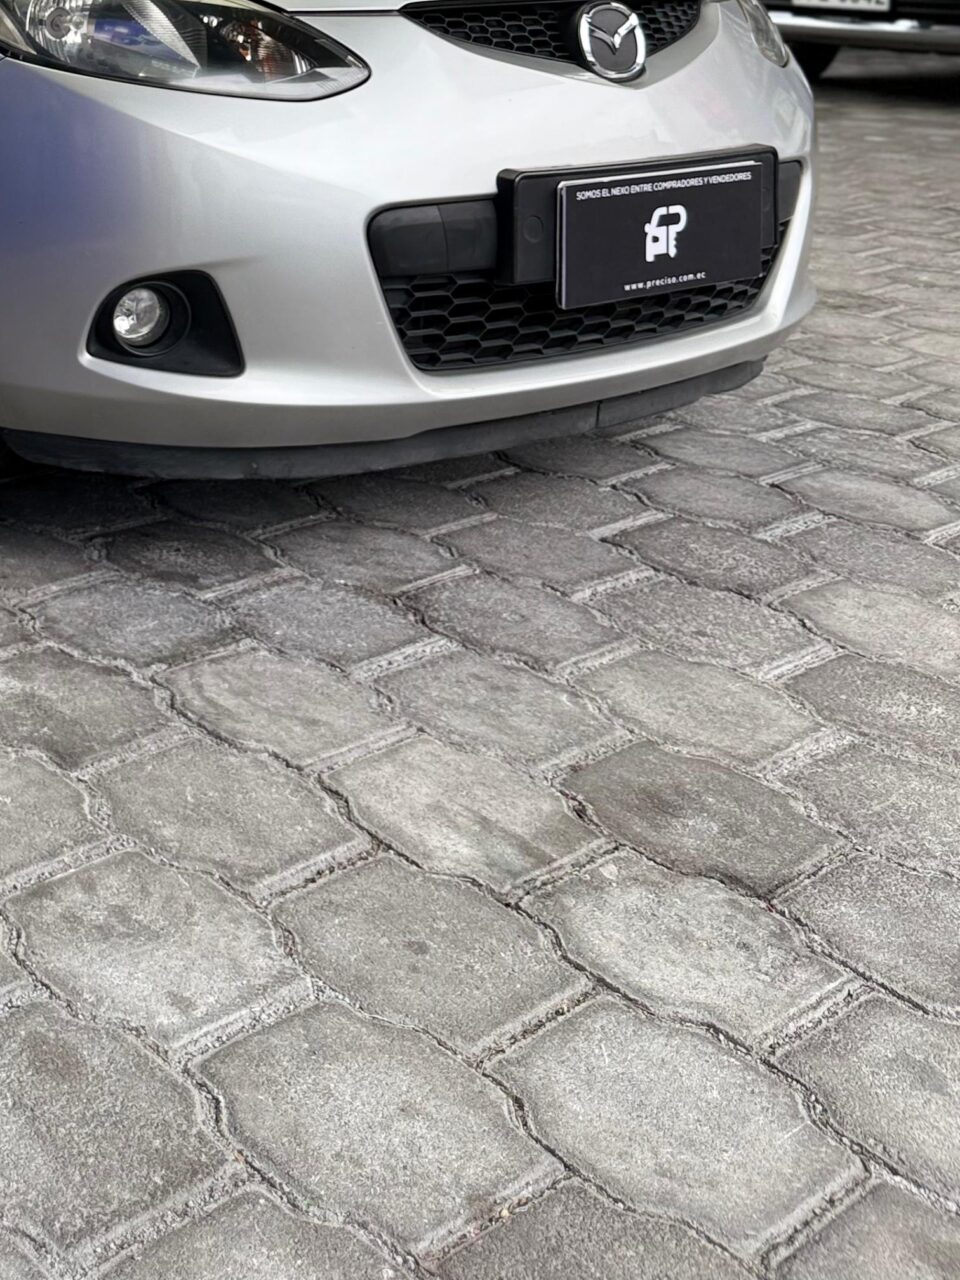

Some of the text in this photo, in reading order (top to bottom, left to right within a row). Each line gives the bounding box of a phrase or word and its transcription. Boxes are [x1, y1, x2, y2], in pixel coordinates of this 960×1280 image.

[576, 171, 752, 201] SOMOS EL NEXO ENTRE COMPRADORES Y VENDEDORES
[623, 271, 707, 292] www.preciso.com.ec
